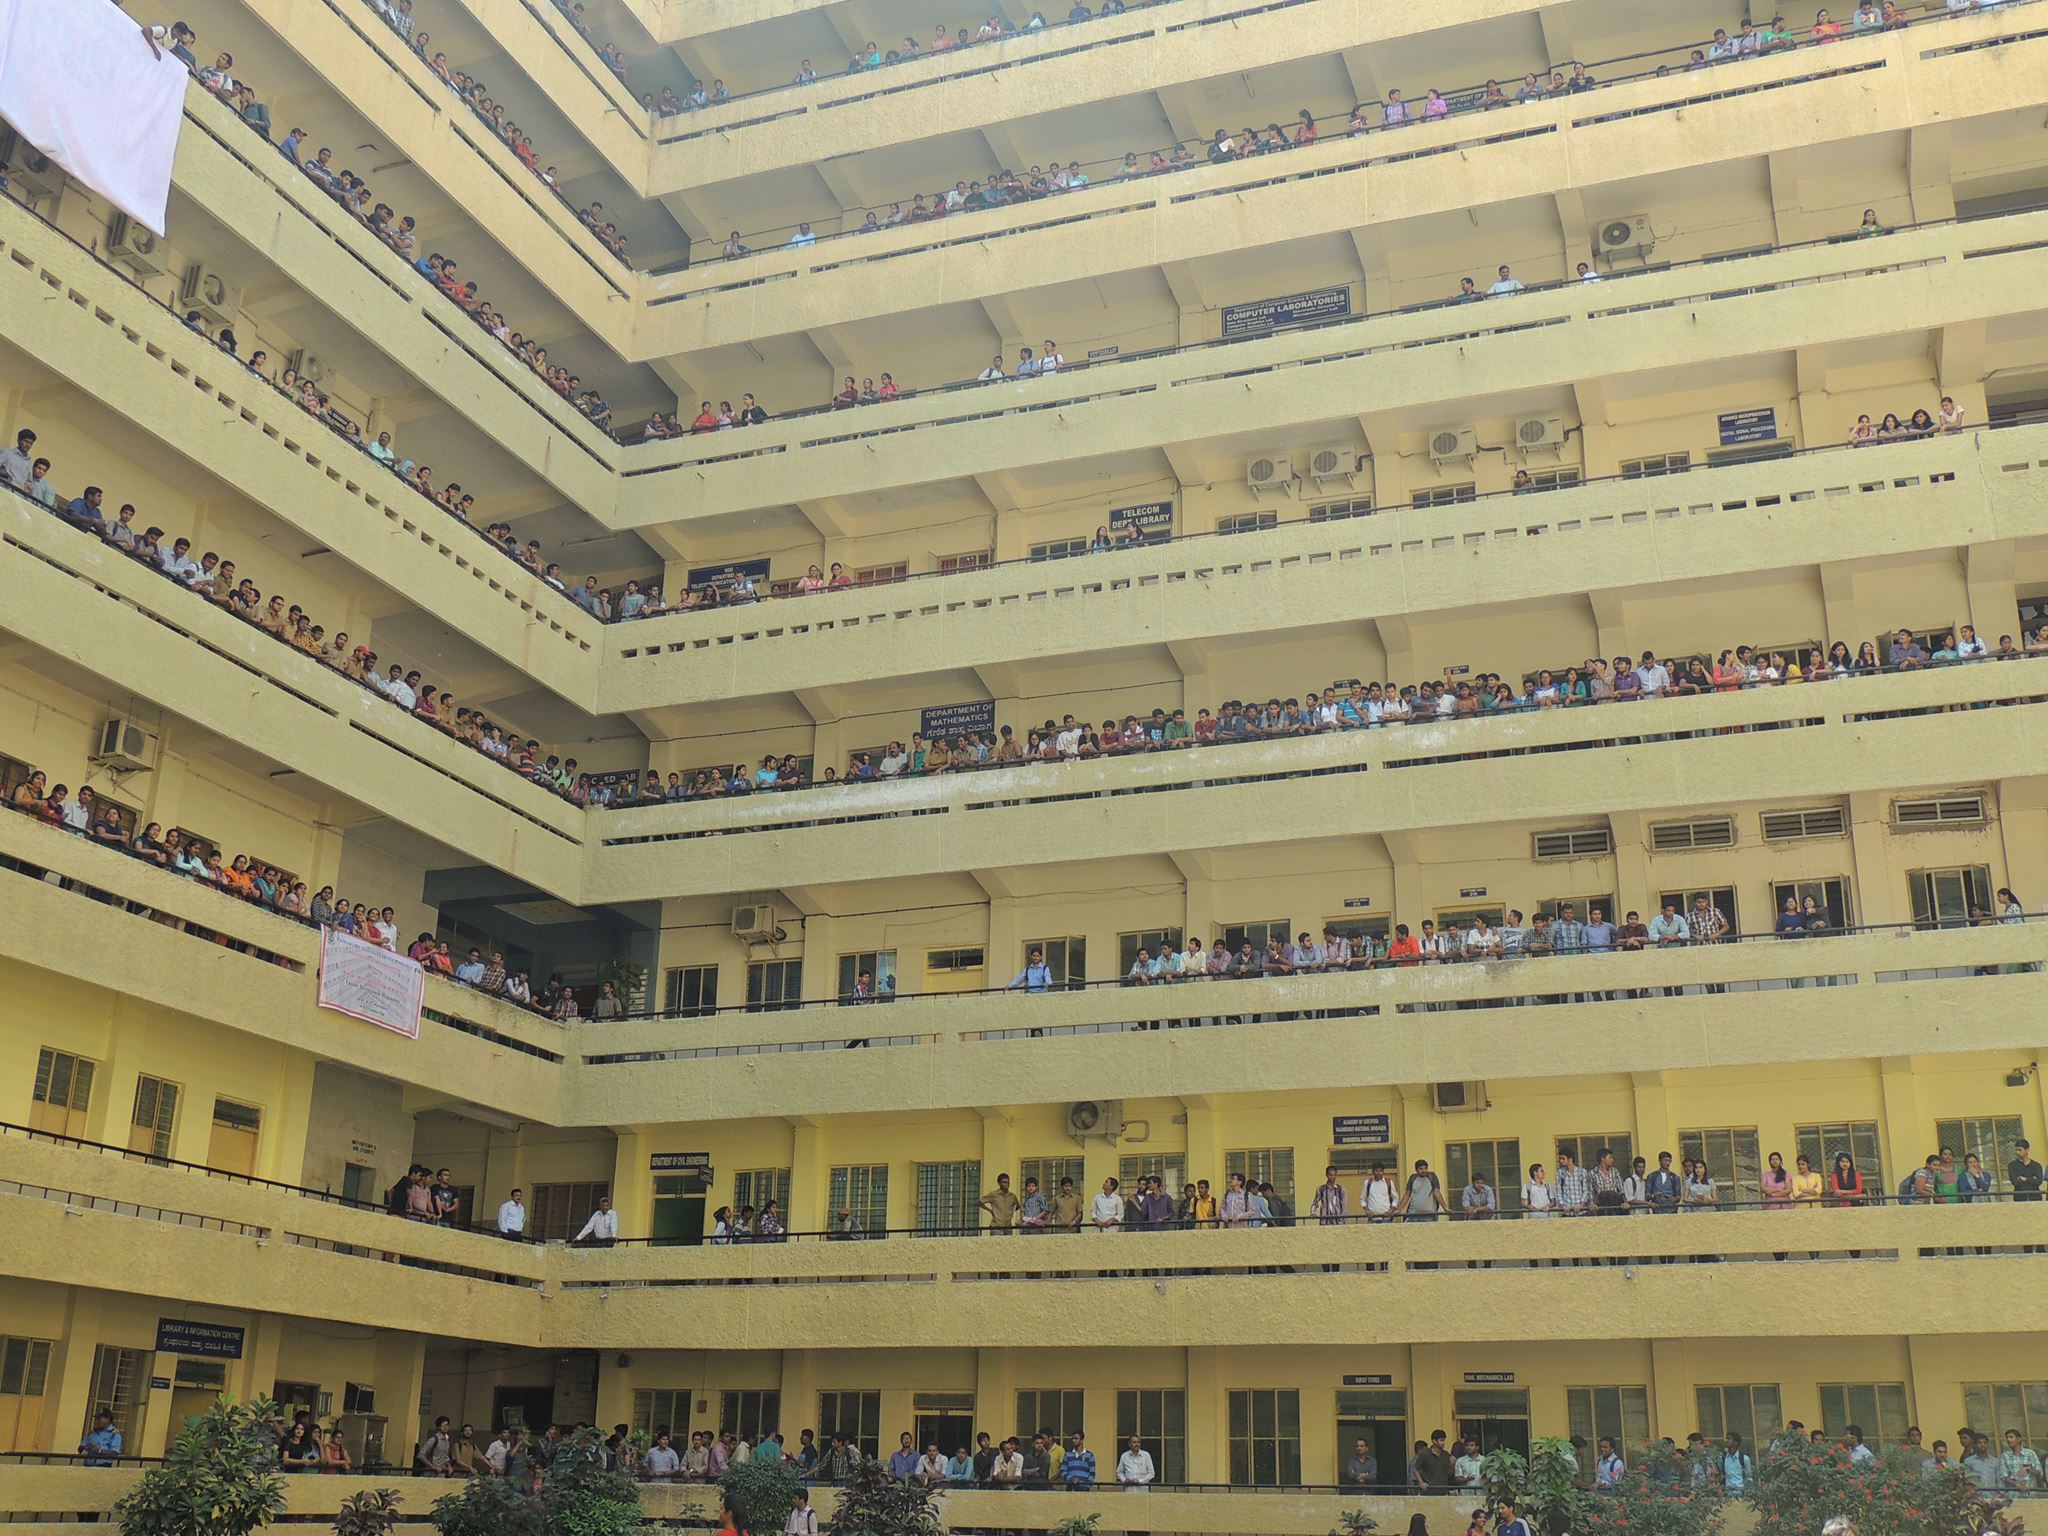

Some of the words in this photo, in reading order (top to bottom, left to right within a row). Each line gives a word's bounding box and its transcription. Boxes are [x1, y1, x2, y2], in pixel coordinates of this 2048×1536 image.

[1226, 307, 1275, 321] COMPUTER
[1277, 294, 1345, 312] LABORATORIES
[1122, 505, 1160, 518] TELECOM
[1135, 513, 1170, 525] LIBRARY
[926, 705, 981, 718] DEPARTMENT
[982, 703, 994, 711] OF
[930, 713, 988, 727] MATHEMATICS
[591, 775, 616, 785] CED
[161, 1324, 184, 1334] LIBRARY
[189, 1327, 221, 1338] INFORMATION
[222, 1331, 240, 1340] CENTRE
